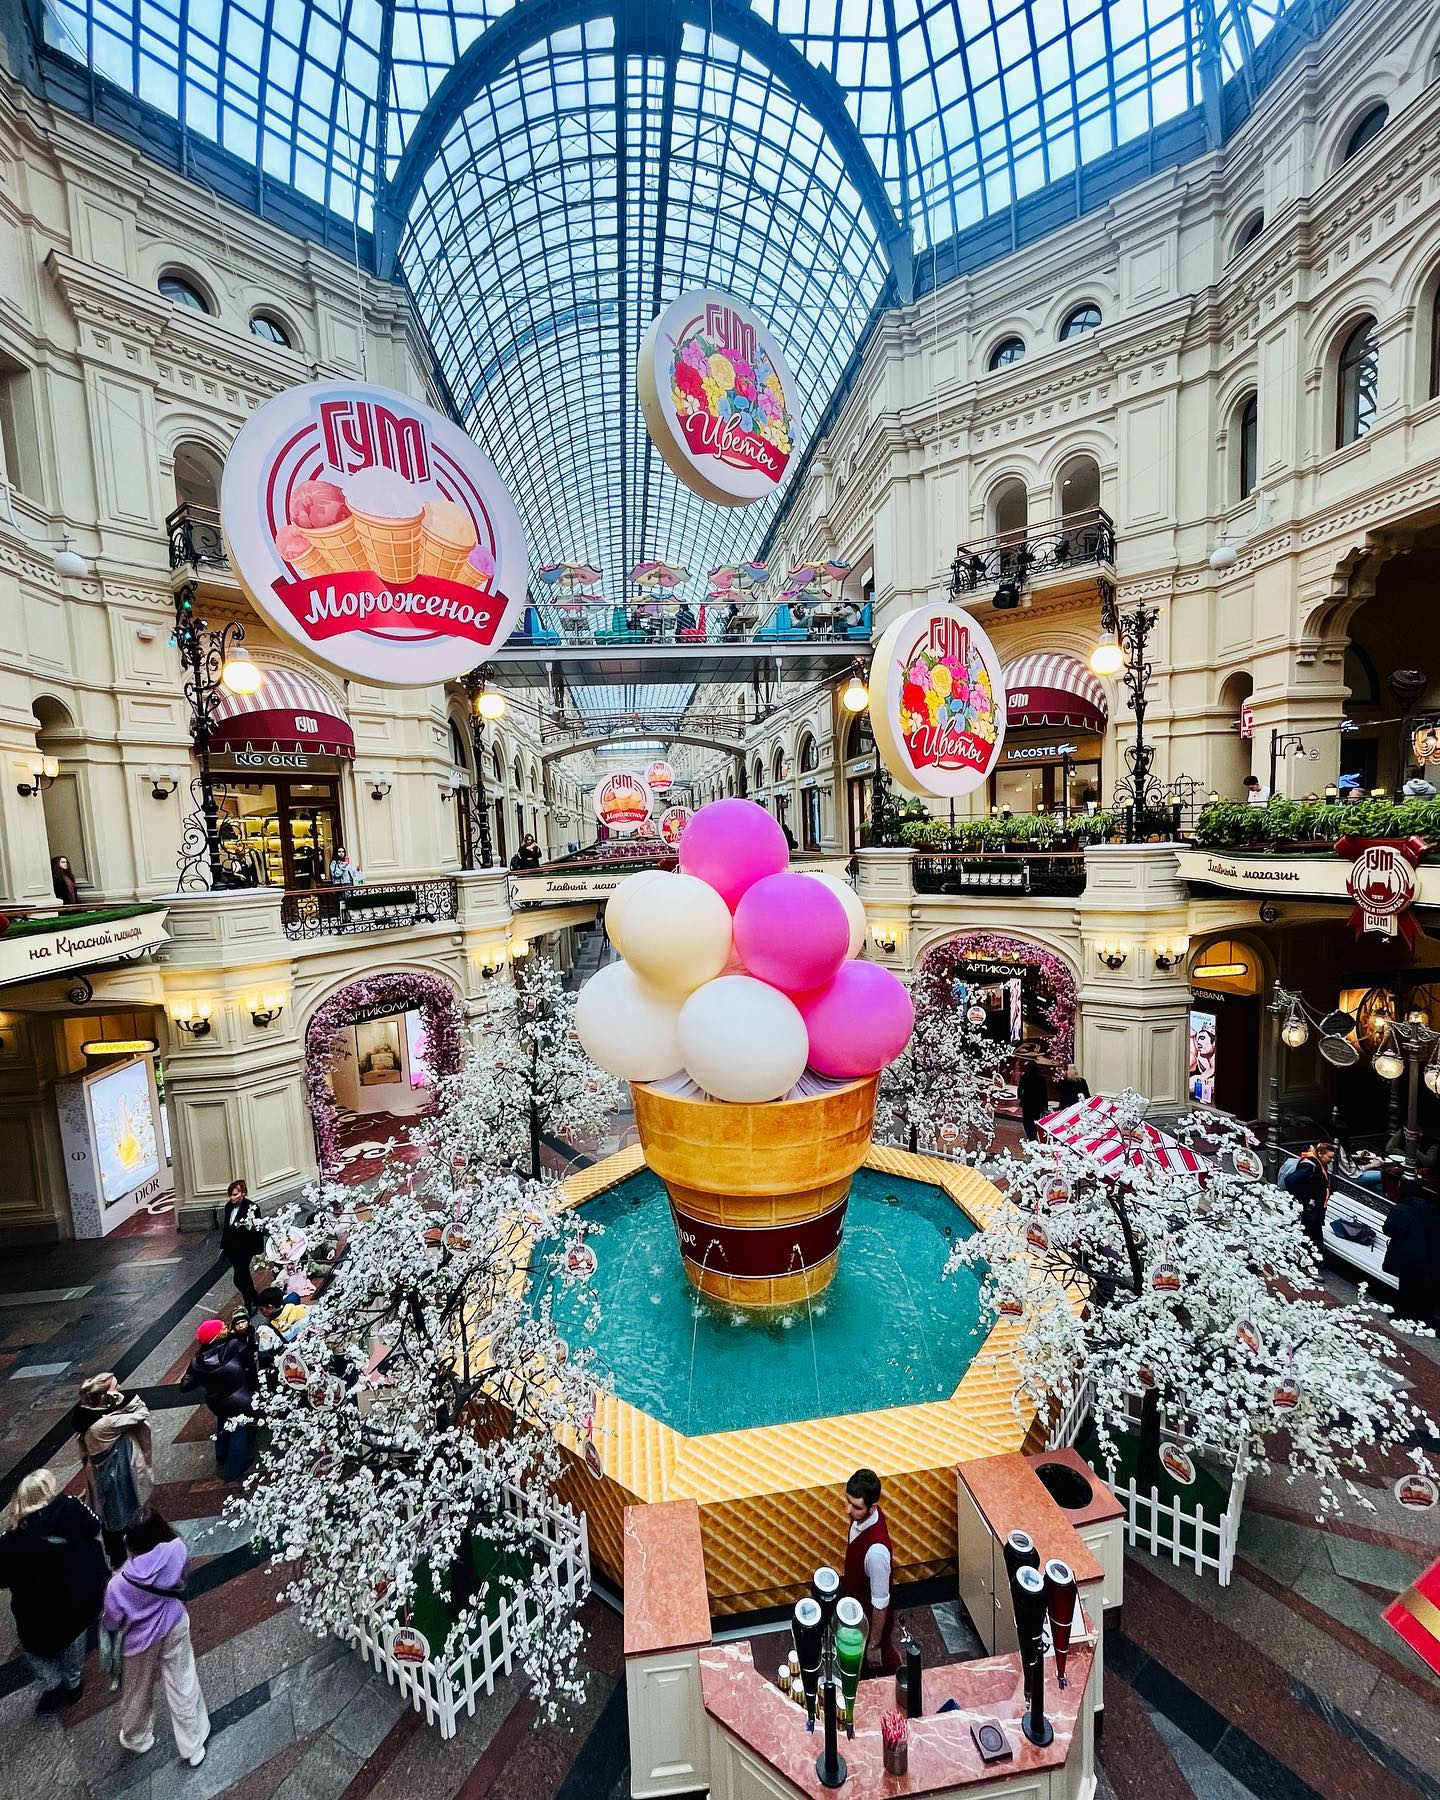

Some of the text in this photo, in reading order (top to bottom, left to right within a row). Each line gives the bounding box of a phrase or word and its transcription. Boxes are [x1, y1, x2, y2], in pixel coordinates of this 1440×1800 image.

[706, 304, 757, 367] ГУМ
[320, 401, 431, 484] ГУМ
[686, 411, 778, 471] Цветы
[304, 586, 491, 630] Мороженое
[929, 617, 972, 668] ГУМ
[911, 717, 985, 767] Цветы
[1007, 746, 1057, 760] LACOSTE
[235, 753, 308, 768] NO ONE
[1366, 849, 1394, 872] ГУМ
[546, 881, 588, 892] Главный
[1242, 870, 1300, 881] магазин
[1367, 915, 1388, 927] GUM
[29, 947, 51, 960] на
[56, 931, 113, 957] Красной
[966, 963, 1027, 977] АРТИКОЛИ
[135, 1178, 160, 1204] DIOR
